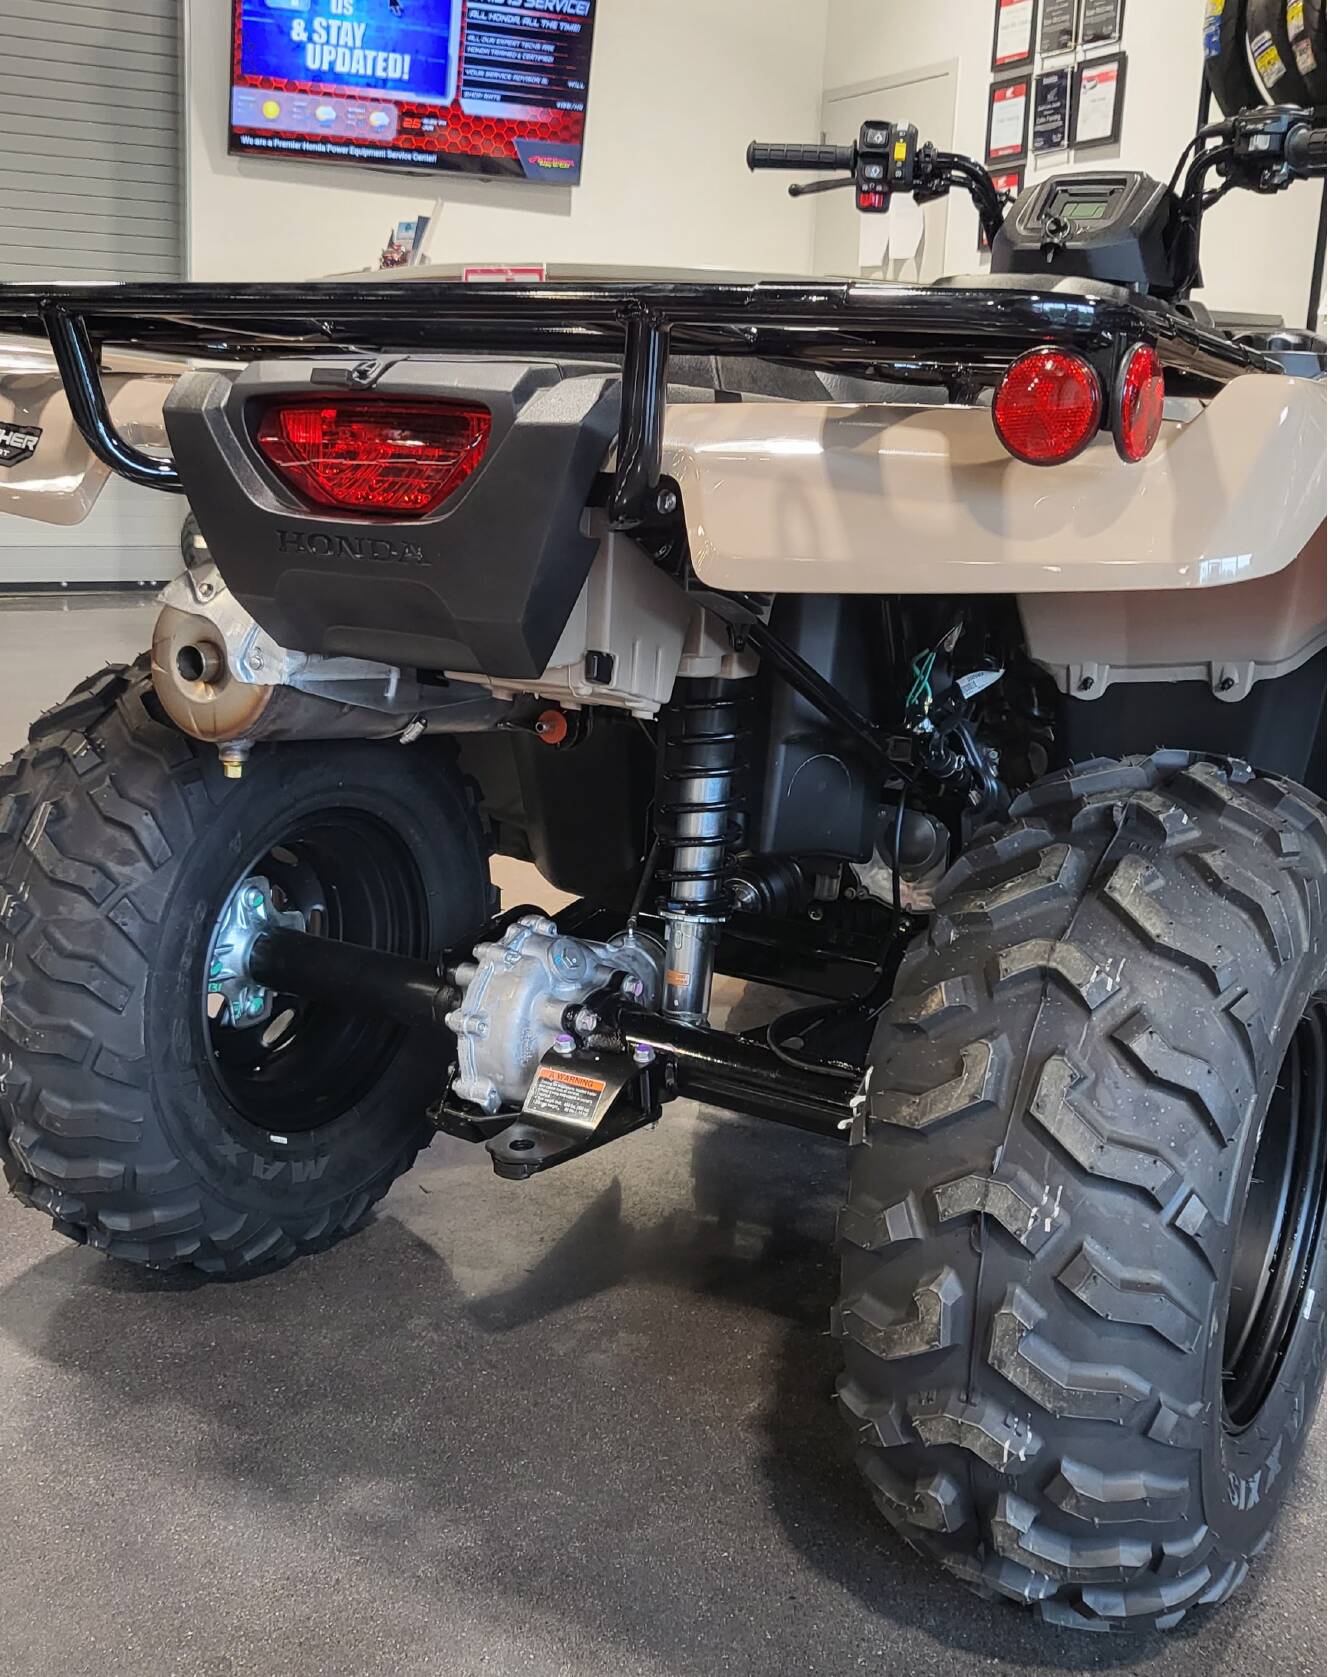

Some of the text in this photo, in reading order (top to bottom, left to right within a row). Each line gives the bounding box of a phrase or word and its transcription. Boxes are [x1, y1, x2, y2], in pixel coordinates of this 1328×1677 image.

[468, 9, 487, 20] ALL
[522, 16, 540, 27] ALL
[290, 17, 367, 48] & STAY
[305, 43, 412, 80] UPDATED!
[240, 135, 254, 146] We
[273, 137, 302, 151] Premier
[302, 140, 326, 153] Honda
[326, 143, 349, 154] Power
[349, 145, 386, 158] Equipment
[387, 148, 412, 161] Service
[274, 529, 432, 567] HONDA
[557, 1073, 594, 1088] WARNING
